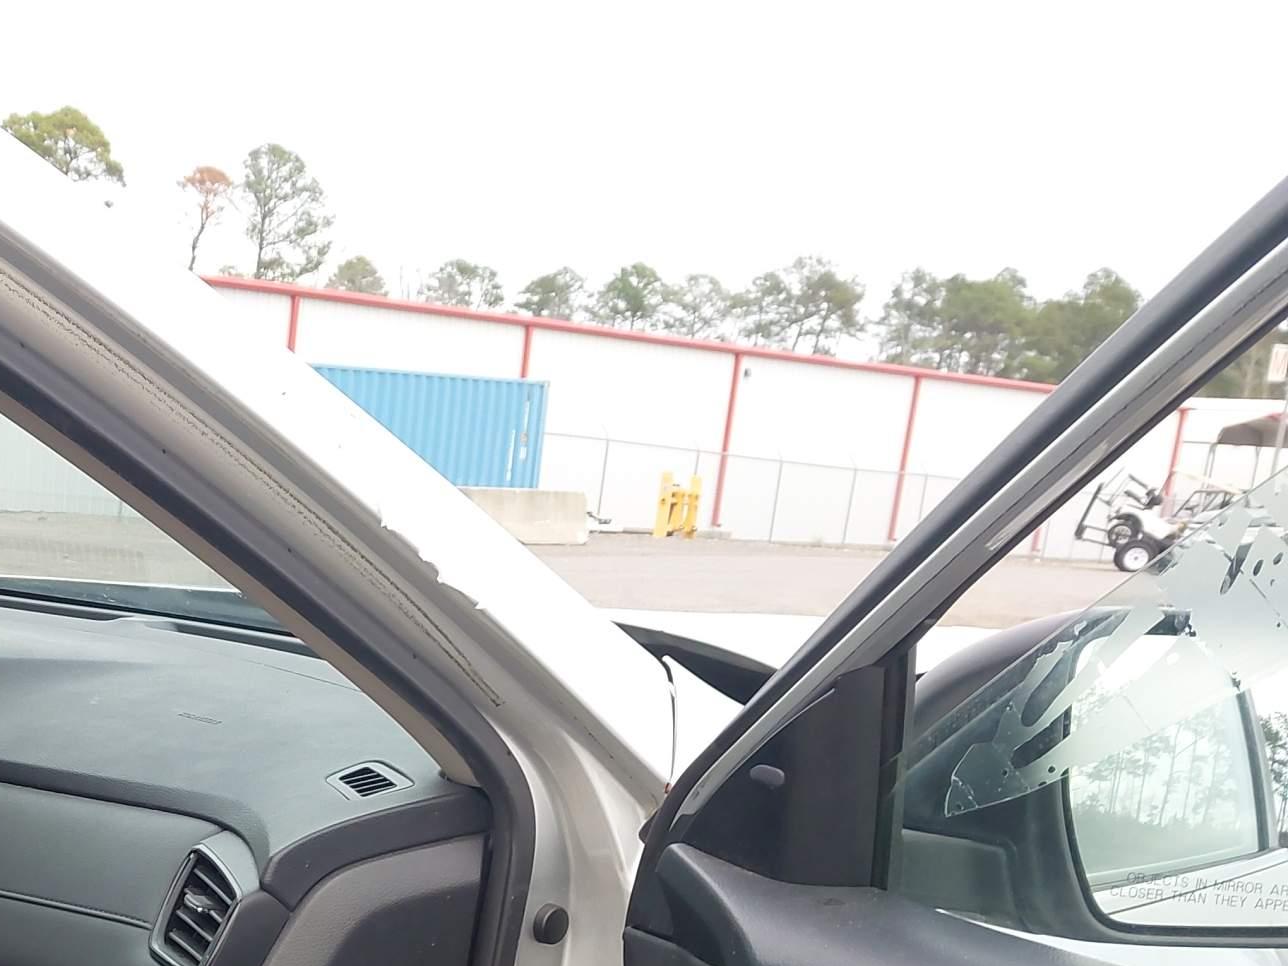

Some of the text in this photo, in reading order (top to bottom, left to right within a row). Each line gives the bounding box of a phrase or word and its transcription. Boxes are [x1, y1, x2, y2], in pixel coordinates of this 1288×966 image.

[1127, 871, 1189, 888] OBJECTS
[1196, 878, 1208, 889] IN
[1215, 879, 1263, 894] MIRROR
[1110, 885, 1163, 900] CLOSER
[1173, 890, 1207, 905] THAN
[1215, 894, 1248, 908] THEY
